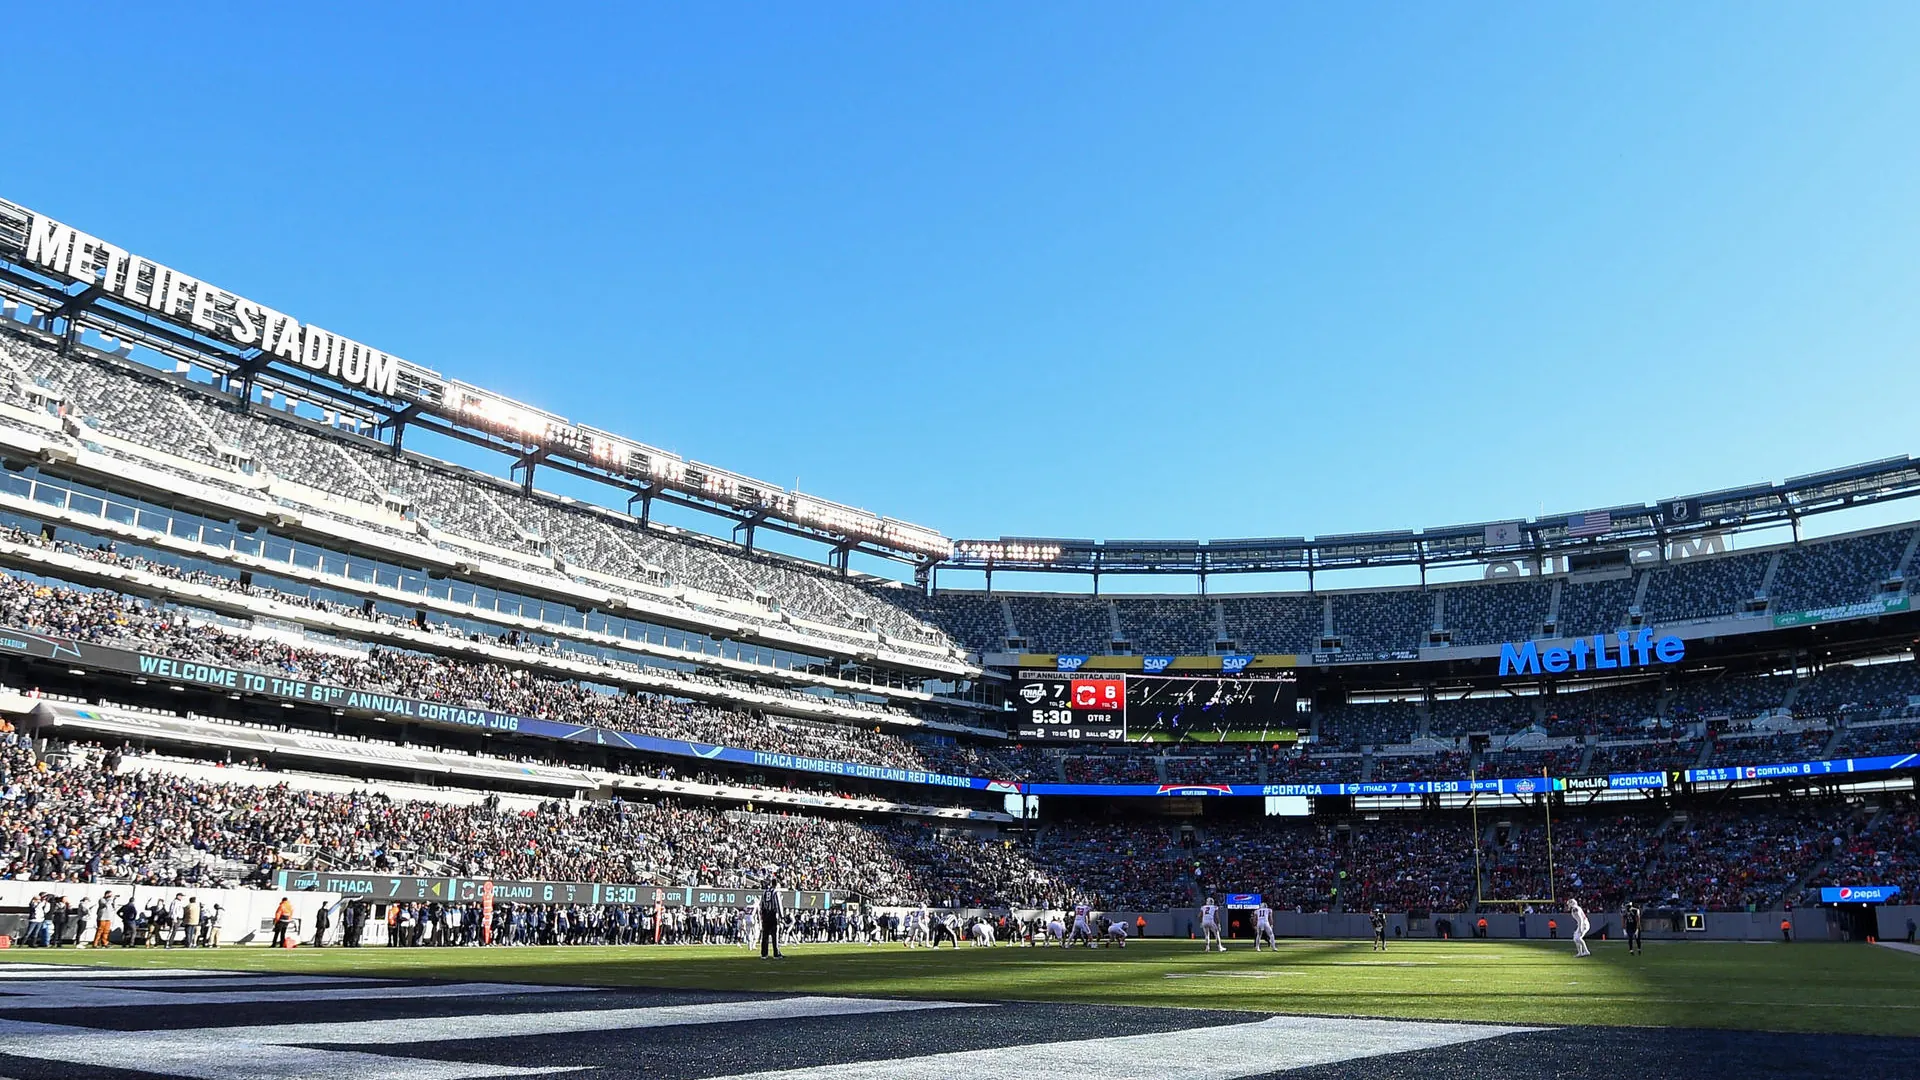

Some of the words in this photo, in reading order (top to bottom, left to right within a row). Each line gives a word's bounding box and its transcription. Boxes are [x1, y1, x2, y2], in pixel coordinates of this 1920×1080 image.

[26, 212, 217, 328] METLIFE
[231, 299, 397, 396] STADIUM
[1498, 627, 1685, 676] MetLife
[1058, 658, 1082, 669] SAP
[1143, 658, 1168, 669] SAP
[1222, 658, 1247, 669] SAP
[140, 656, 238, 687] WELCOME
[243, 673, 266, 692] TO
[272, 679, 305, 698] THE
[311, 685, 345, 703] 61ST
[348, 692, 414, 715] ANNUAL
[419, 703, 486, 727] CORTACA
[490, 714, 518, 731] JUG
[1053, 684, 1065, 698] 7
[1076, 685, 1096, 705] C
[1105, 685, 1116, 699] 6
[1059, 700, 1065, 708] 2
[1111, 701, 1118, 709] 3
[1032, 709, 1072, 724] 5:30
[1105, 714, 1111, 722] 2
[1037, 728, 1045, 738] 2
[1067, 728, 1080, 739] 10
[1108, 729, 1123, 739] 37
[754, 752, 793, 768] ITHACA
[795, 758, 843, 774] BOMBERS
[856, 765, 906, 780] CORTLAND
[908, 771, 926, 783] RED
[928, 773, 971, 788] DRAGONS
[1757, 766, 1798, 776] CORTLAND
[1803, 764, 1811, 773] 6
[1611, 776, 1662, 786] #CORTACA
[1672, 772, 1680, 783] 7
[1363, 784, 1387, 792] ITHACA
[1391, 783, 1398, 792] 7
[1434, 781, 1459, 792] 5:30
[1569, 778, 1608, 789] MetLife
[1262, 784, 1322, 795] #CORTACA
[326, 879, 373, 893] ITHACA
[389, 879, 401, 897] 7
[416, 879, 428, 887] TOL
[418, 888, 425, 898] 2
[544, 885, 554, 901] 6
[565, 884, 576, 892] TOL
[568, 893, 574, 901] 3
[605, 886, 637, 903] 5:30
[667, 892, 681, 901] QTR
[699, 892, 716, 903] 2ND
[719, 894, 725, 903] &
[727, 893, 735, 904] 10
[1854, 889, 1881, 899] pepsi
[810, 895, 817, 907] 7
[1205, 906, 1211, 915] 2
[1258, 909, 1265, 918] 11
[1690, 916, 1698, 927] 7
